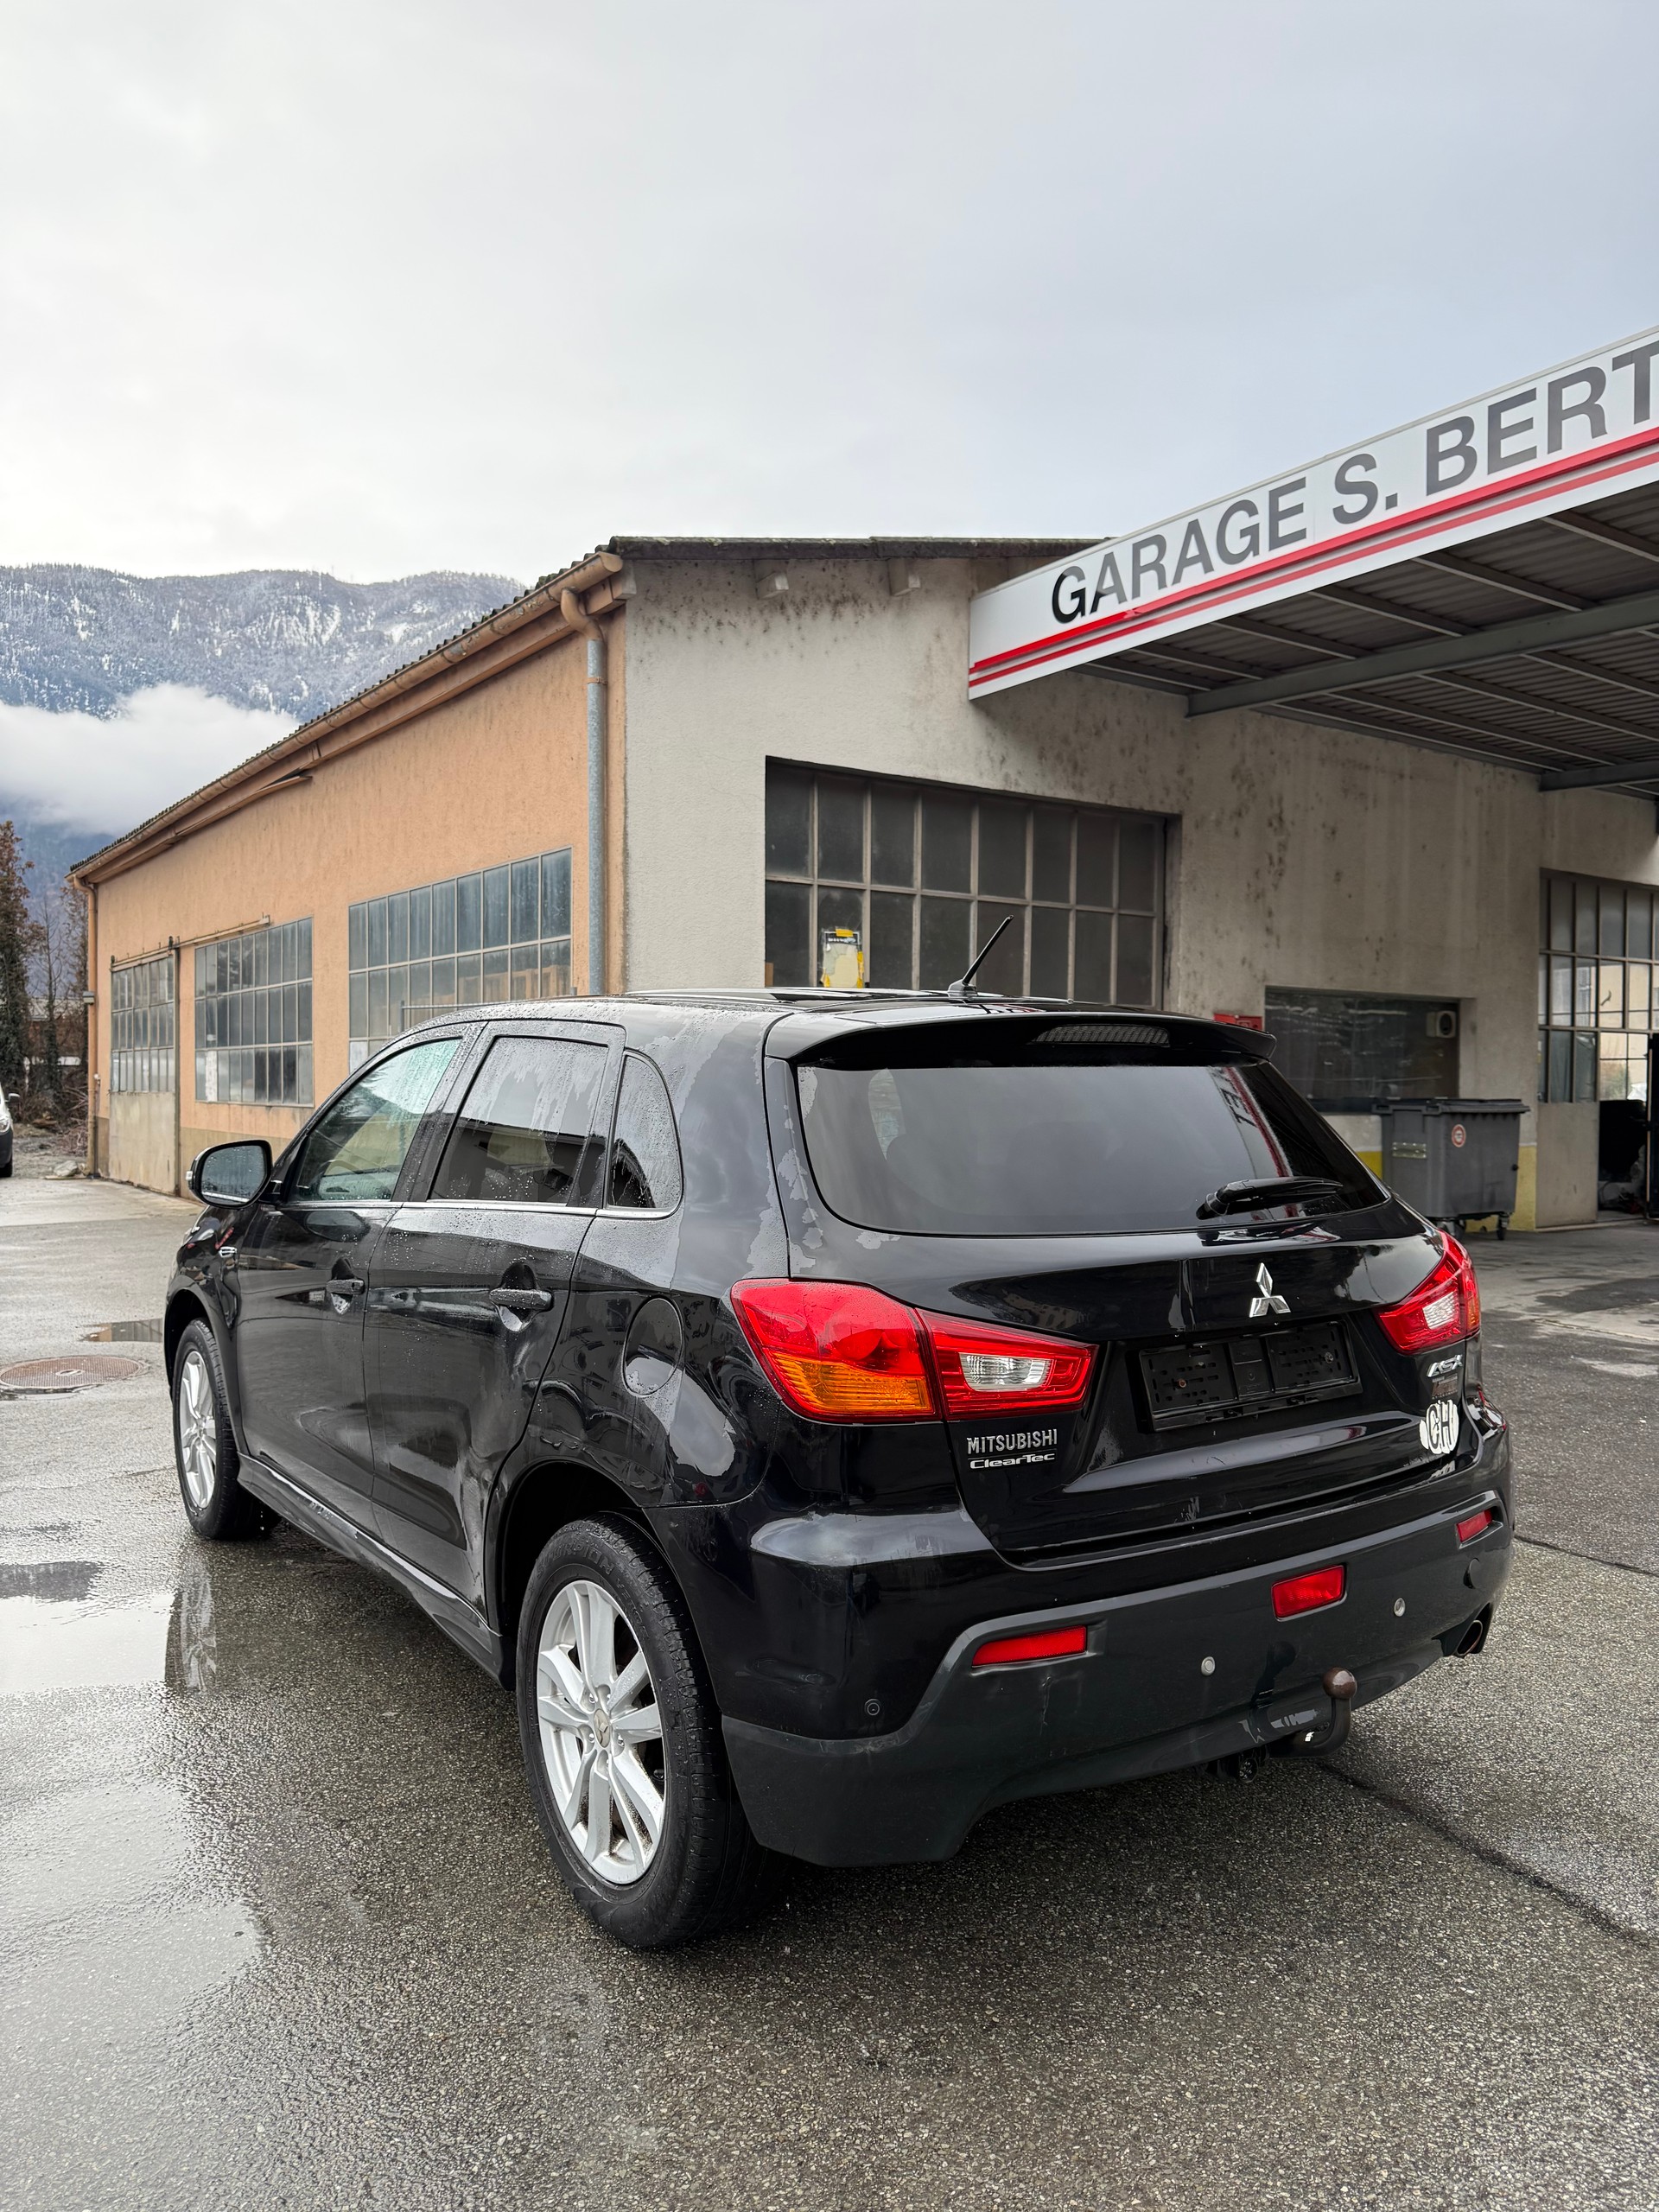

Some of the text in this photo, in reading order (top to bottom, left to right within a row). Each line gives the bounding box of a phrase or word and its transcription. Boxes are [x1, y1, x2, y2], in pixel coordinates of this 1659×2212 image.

[1052, 339, 1659, 624] GARAGE S. BERT
[1427, 1355, 1462, 1376] ASX
[967, 1428, 1058, 1454] MITSUBISHI
[970, 1453, 1055, 1469] ClearTec
